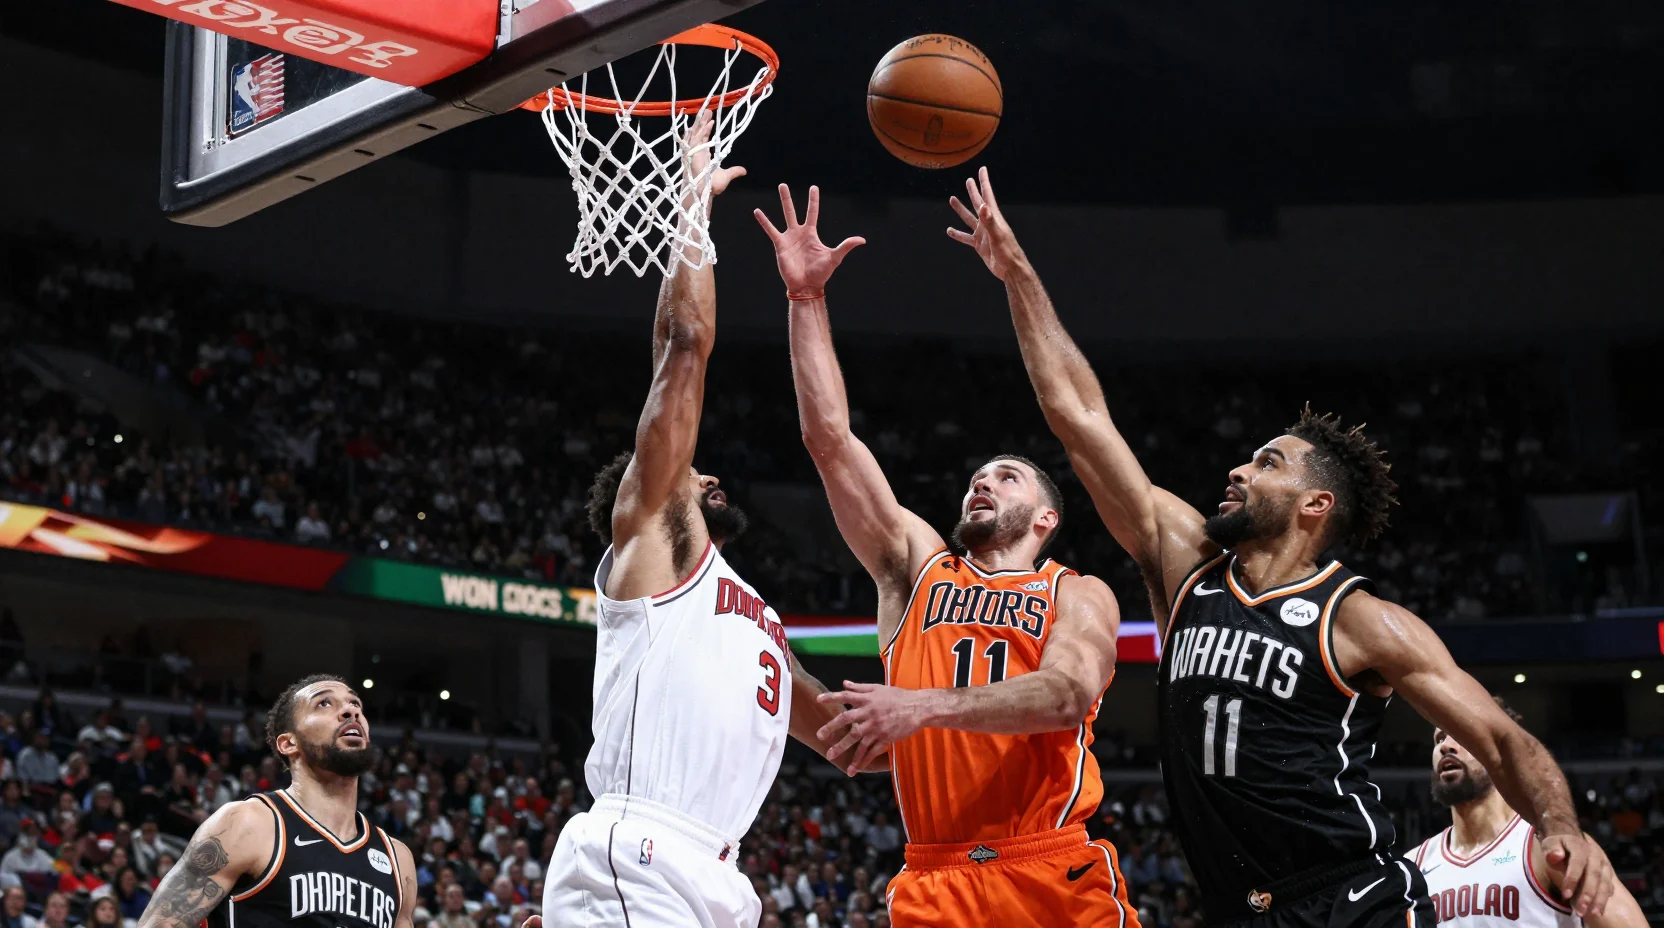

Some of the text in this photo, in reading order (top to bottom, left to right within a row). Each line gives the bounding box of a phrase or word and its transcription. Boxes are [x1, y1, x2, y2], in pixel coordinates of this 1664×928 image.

[756, 650, 781, 717] 3
[951, 637, 1009, 688] 11
[1203, 695, 1243, 777] 11
